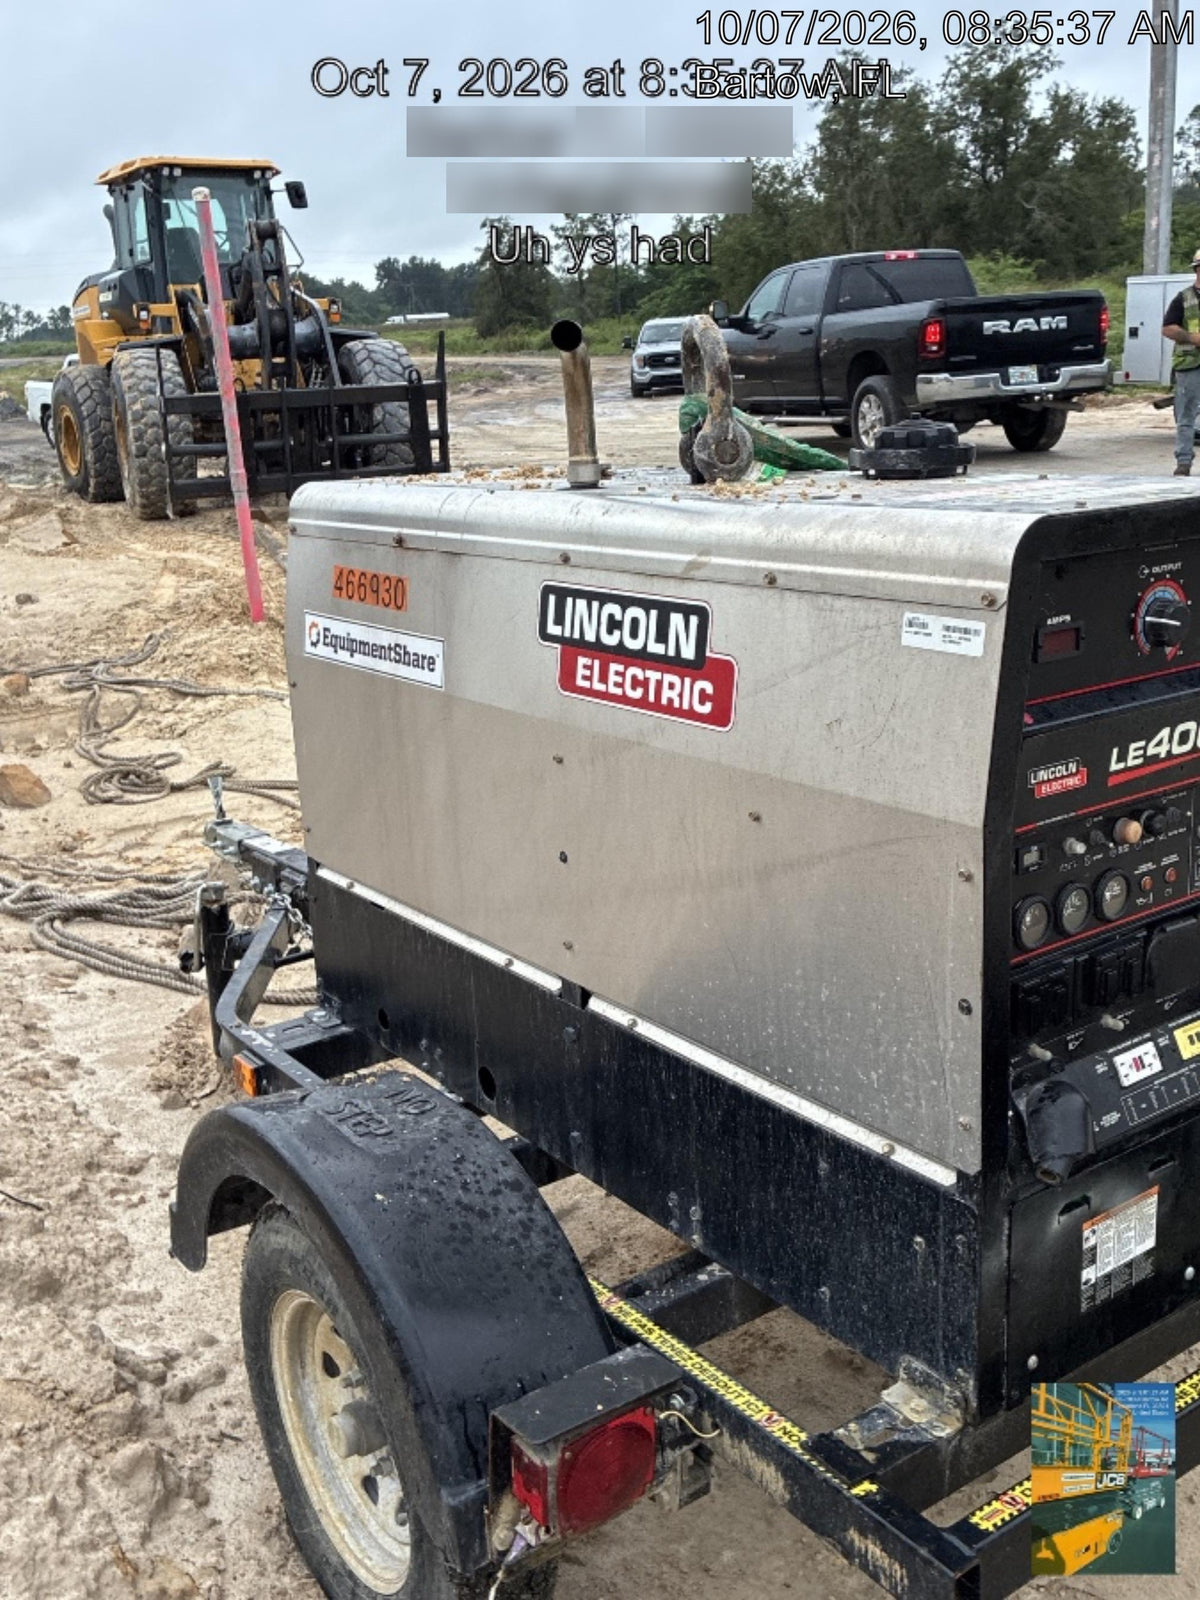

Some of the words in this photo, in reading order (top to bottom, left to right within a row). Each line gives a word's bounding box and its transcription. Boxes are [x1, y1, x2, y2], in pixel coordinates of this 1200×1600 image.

[982, 315, 1068, 336] RAM
[333, 567, 405, 611] 466930
[322, 626, 437, 673] EquipmentShare
[546, 593, 700, 661] LINCOLN
[575, 655, 714, 715] ELECTRIC
[1108, 720, 1200, 772] LE40
[1030, 761, 1077, 784] LINCOLN
[1041, 774, 1082, 794] ELECTRIC
